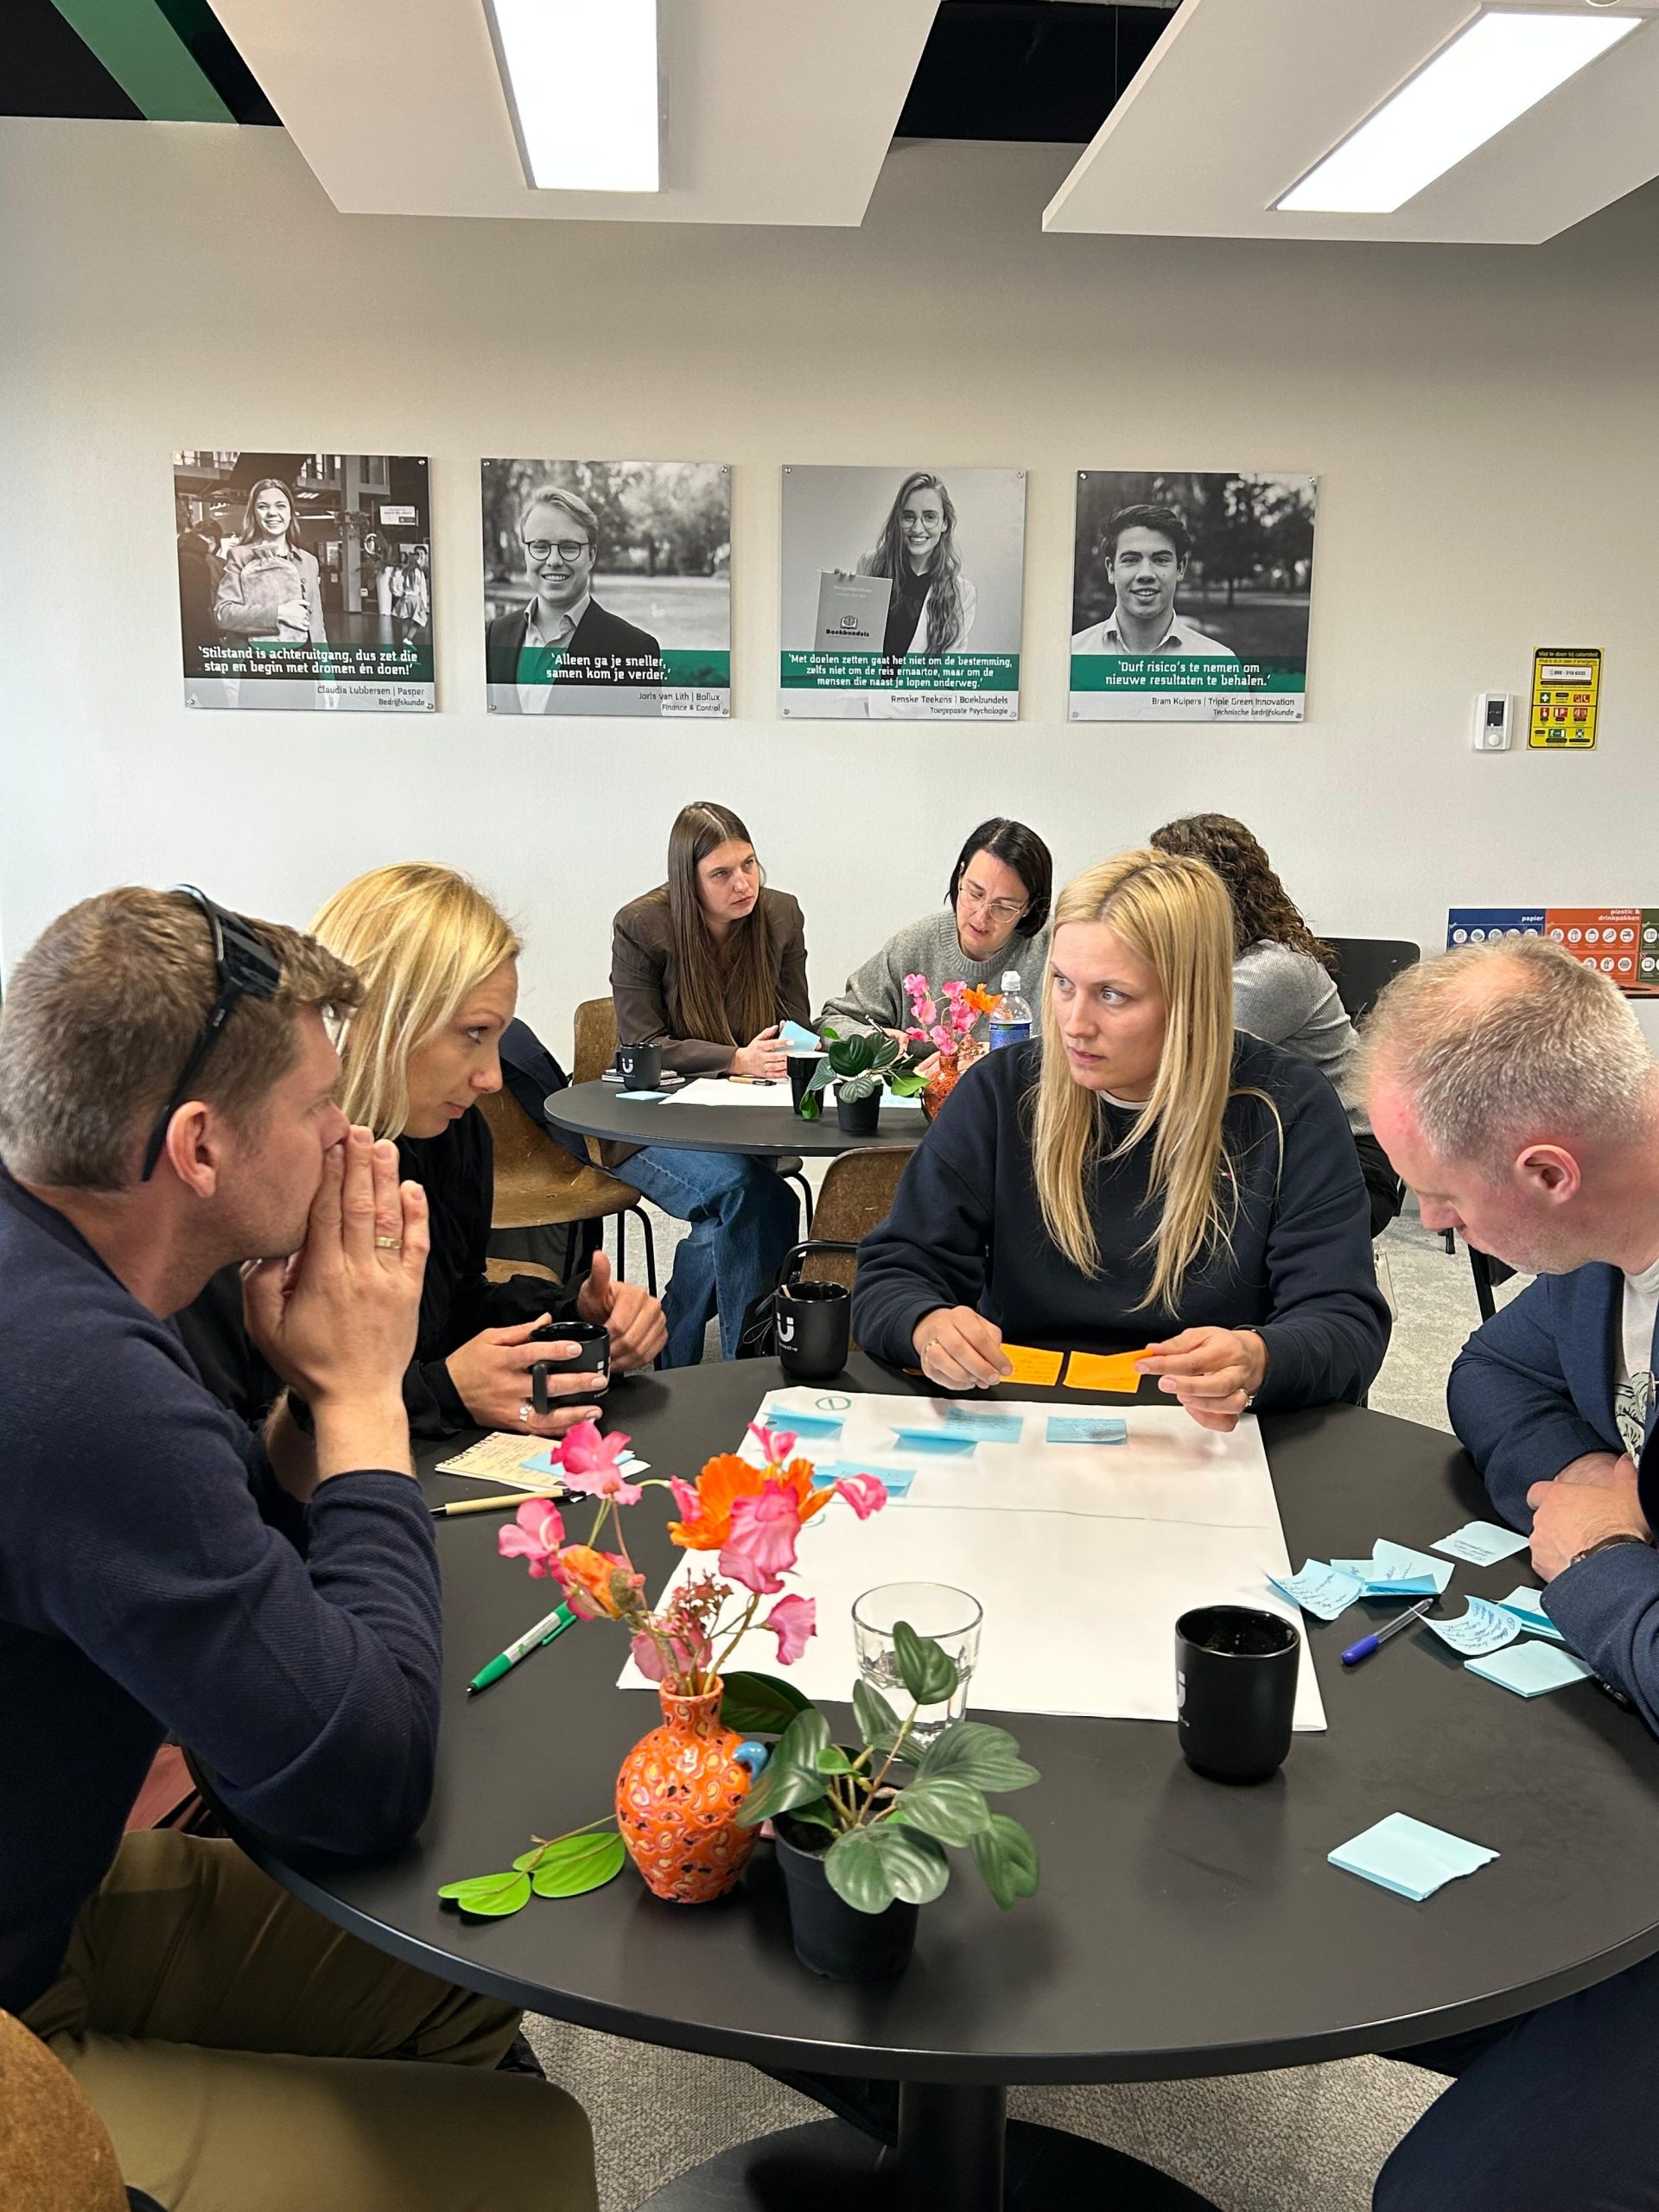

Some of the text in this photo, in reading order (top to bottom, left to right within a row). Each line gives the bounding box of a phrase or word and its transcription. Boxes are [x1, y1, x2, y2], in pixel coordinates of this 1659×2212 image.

[257, 647, 266, 659] is
[269, 648, 353, 664] achteruitgang,
[356, 650, 376, 662] dus
[380, 651, 397, 662] zet
[400, 651, 418, 663] die
[810, 654, 840, 664] doelen
[842, 656, 868, 665] zetten
[871, 657, 890, 667] gaat
[893, 655, 907, 665] het
[909, 656, 926, 666] niet
[944, 656, 956, 666] de
[958, 656, 1013, 668] bestemming,
[204, 661, 229, 674] stap
[232, 664, 247, 672] en
[251, 661, 283, 674] begin
[286, 663, 308, 673] met
[312, 662, 356, 674] dromen
[359, 663, 374, 675] én
[594, 657, 608, 669] ga
[610, 655, 622, 670] je
[626, 655, 666, 669] sneller,
[1189, 663, 1200, 673] te
[1203, 664, 1239, 673] nemen
[1243, 664, 1260, 673] om
[546, 669, 582, 679] samen
[586, 668, 611, 680] kom
[613, 669, 625, 682] je
[806, 665, 826, 675] zelfs
[830, 666, 846, 676] niet
[865, 666, 876, 676] de
[878, 666, 894, 676] reis
[943, 668, 964, 677] maar
[982, 667, 995, 677] de
[817, 677, 851, 686] mensen
[854, 677, 868, 687] die
[869, 677, 893, 687] naast
[895, 677, 904, 689] je
[906, 677, 931, 689] lopen
[1105, 675, 1147, 685] nieuwe
[1149, 675, 1204, 686] resultaten
[1206, 676, 1217, 686] te
[397, 688, 425, 696] Pasper
[378, 698, 425, 708] Bedrijfskunde
[891, 695, 919, 703] Renske
[921, 695, 952, 704] Teekens
[959, 696, 1008, 704] Boekbundels
[1173, 697, 1202, 707] Kuipers
[1208, 698, 1229, 707] Triple
[930, 707, 1008, 716] Toegepaste Psychologie
[1250, 709, 1295, 718] bedrijfskunde
